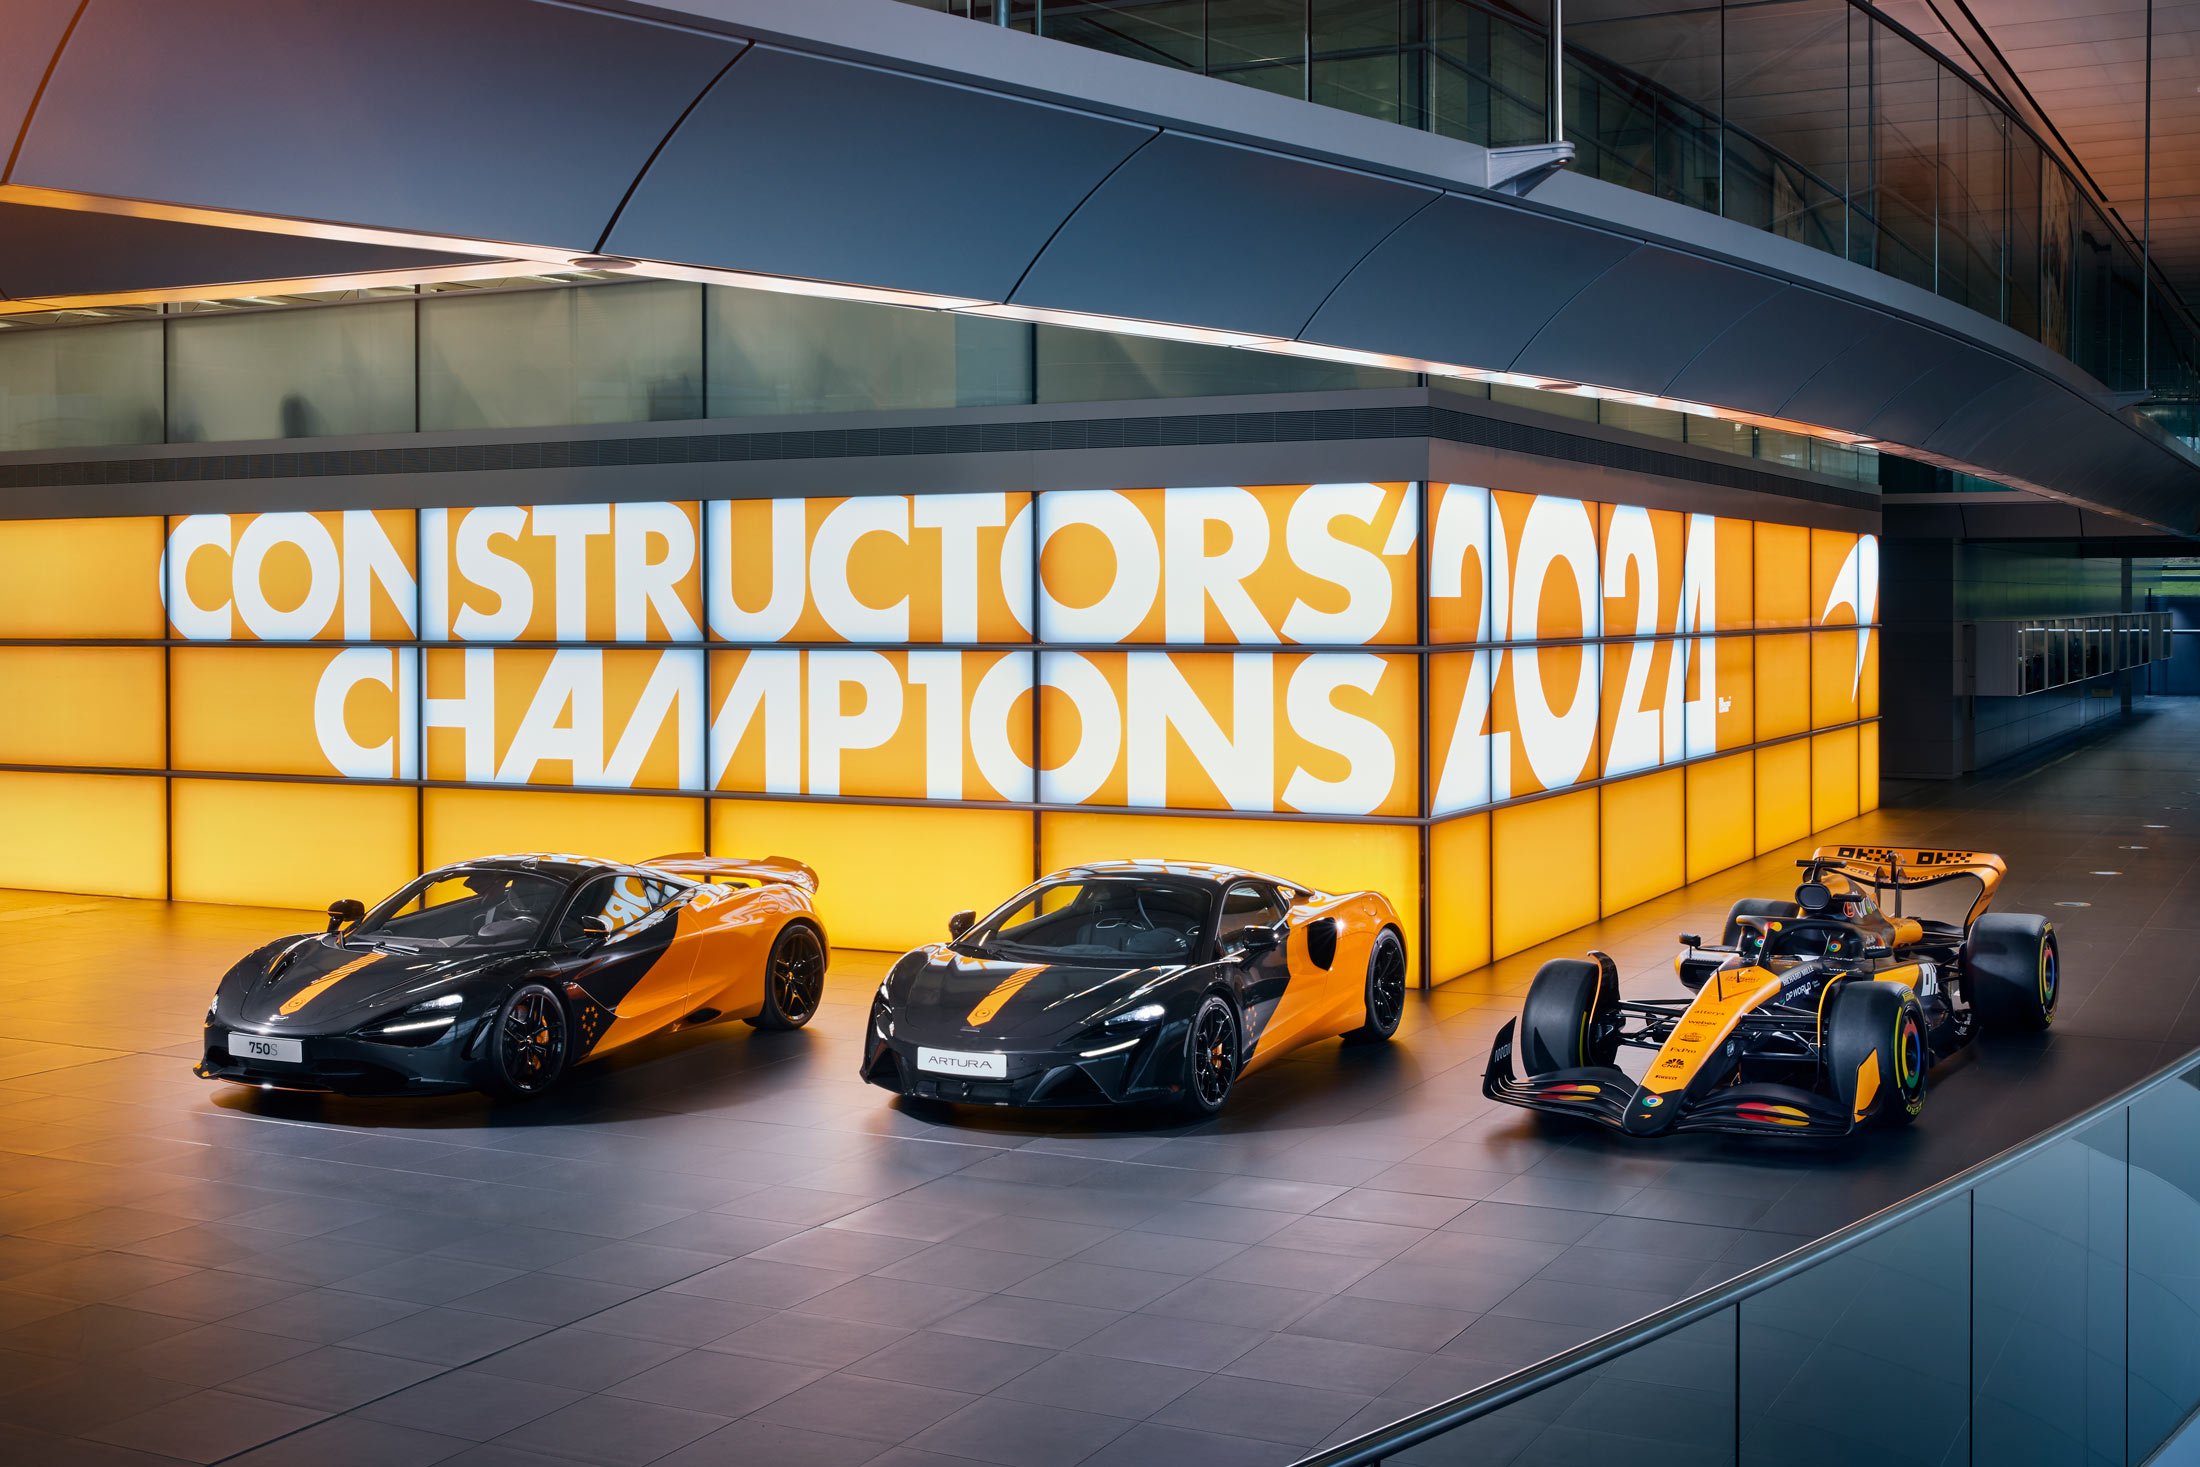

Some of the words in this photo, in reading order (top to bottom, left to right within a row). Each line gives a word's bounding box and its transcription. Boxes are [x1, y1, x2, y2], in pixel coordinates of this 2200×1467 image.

[1430, 484, 1716, 817] 2024
[1916, 851, 1973, 865] OKX
[1782, 971, 1802, 986] RICHARD
[1801, 964, 1815, 977] MILLE
[1793, 981, 1812, 998] WORLD
[249, 1041, 278, 1056] 750S
[928, 1055, 992, 1070] ARTURA
[1661, 1062, 1685, 1070] CNBC
